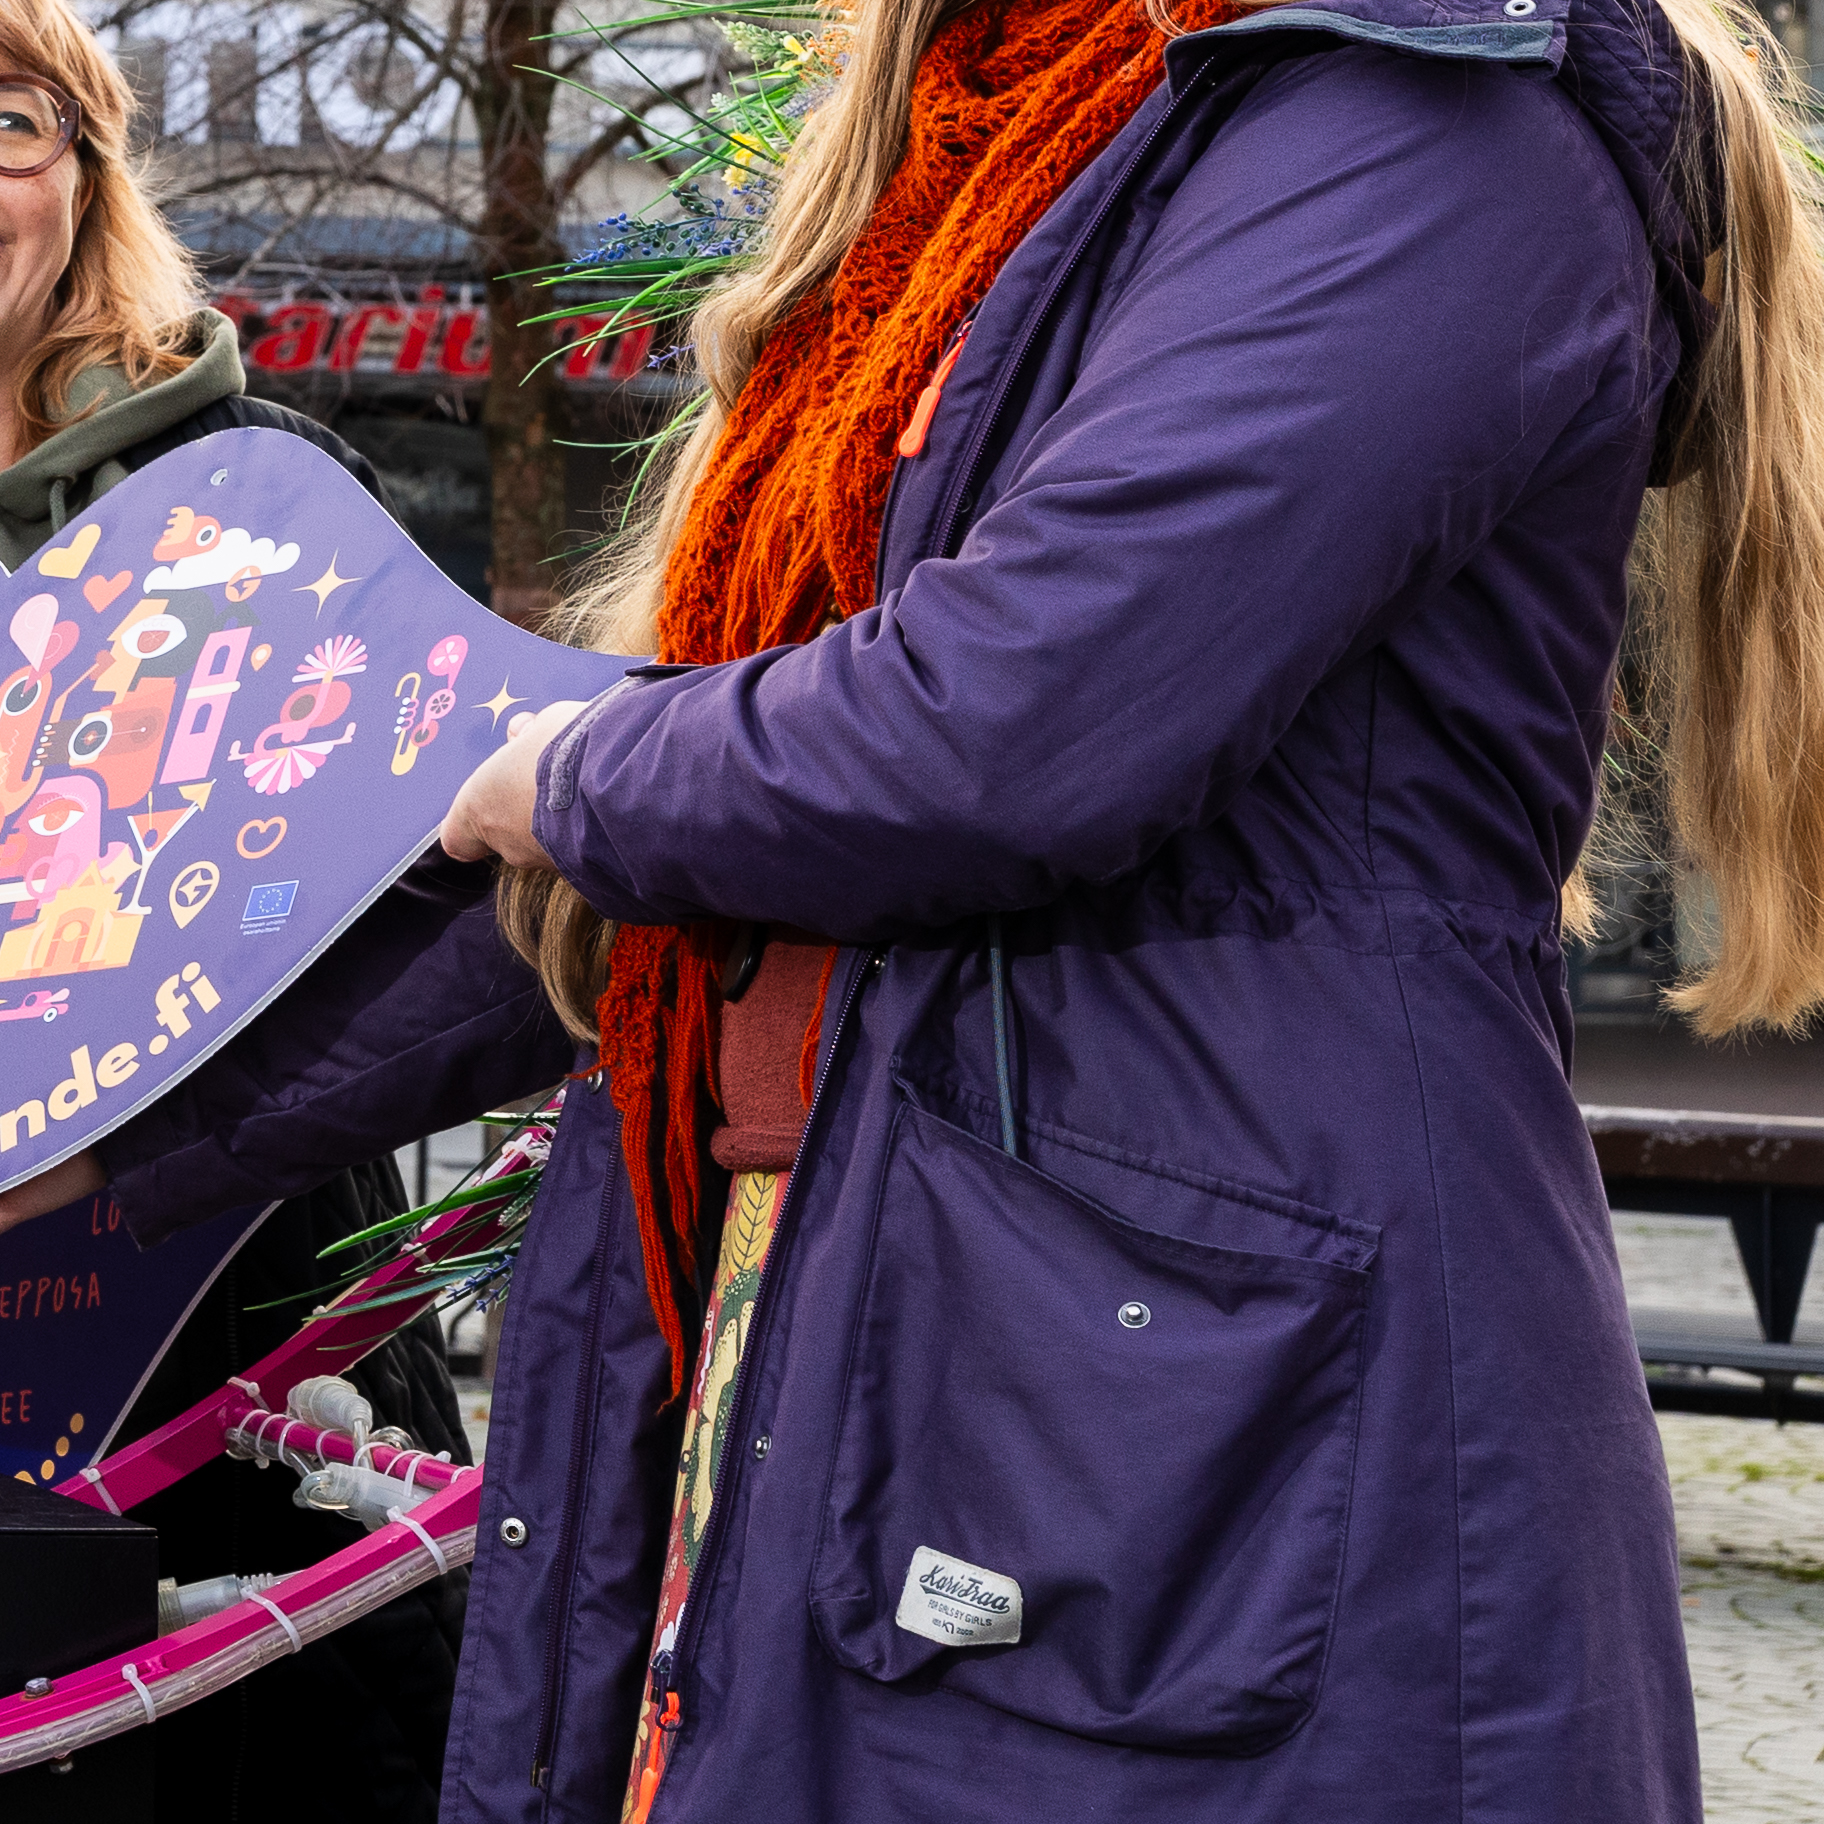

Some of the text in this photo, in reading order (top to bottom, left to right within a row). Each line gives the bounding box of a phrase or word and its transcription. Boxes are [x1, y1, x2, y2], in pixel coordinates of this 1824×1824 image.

[958, 1577, 1010, 1612] Traa
[938, 1603, 954, 1617] GIRLS
[965, 1613, 993, 1627] GIRLS
